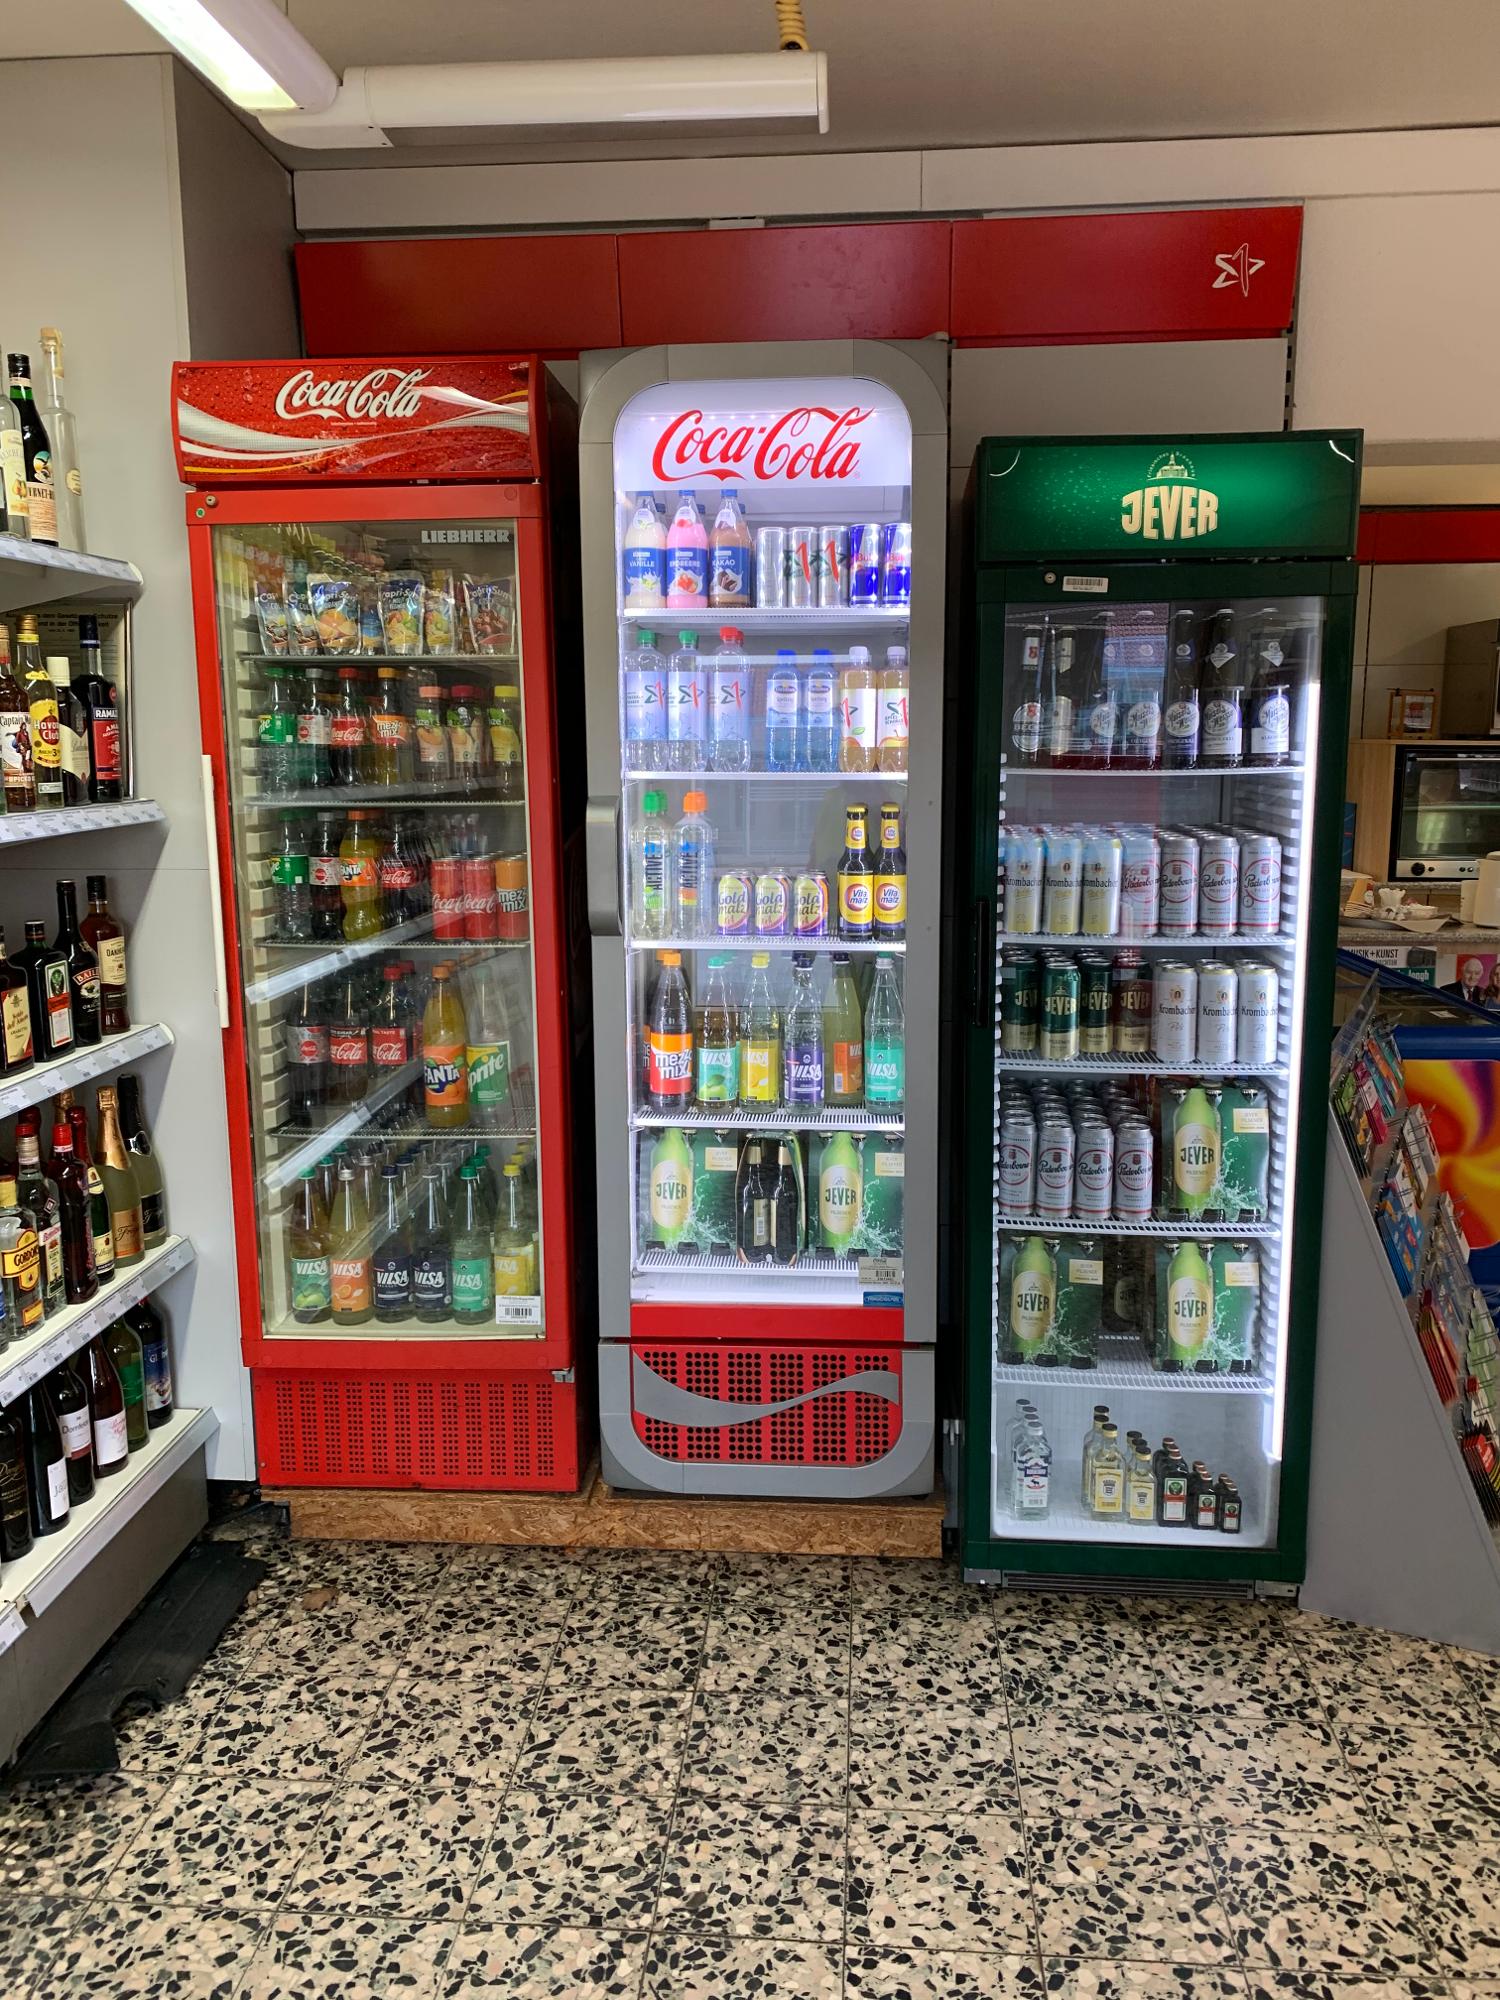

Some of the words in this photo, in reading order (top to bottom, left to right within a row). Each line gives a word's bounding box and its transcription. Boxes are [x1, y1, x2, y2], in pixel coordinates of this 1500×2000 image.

[275, 367, 433, 421] Coca-Cola
[652, 406, 875, 482] Coca-Cola
[1122, 485, 1219, 540] JEVER
[421, 529, 510, 543] LIEBHERR
[646, 854, 663, 891] ACTIVE
[501, 901, 526, 912] mix
[76, 969, 100, 982] BAIL
[659, 1062, 689, 1079] mix
[792, 1064, 822, 1081] VILSA
[867, 1063, 898, 1080] VILSA
[1180, 1146, 1214, 1165] JEVER
[656, 1182, 688, 1200] JEVER
[825, 1188, 857, 1206] JEVER
[296, 1261, 329, 1275] VILSA
[332, 1262, 363, 1278] VILSA
[377, 1270, 410, 1287] VILSA
[414, 1271, 445, 1288] VILSA
[452, 1273, 483, 1290] VILSA
[1017, 1293, 1050, 1312] JEVER
[1174, 1299, 1207, 1318] JEVER
